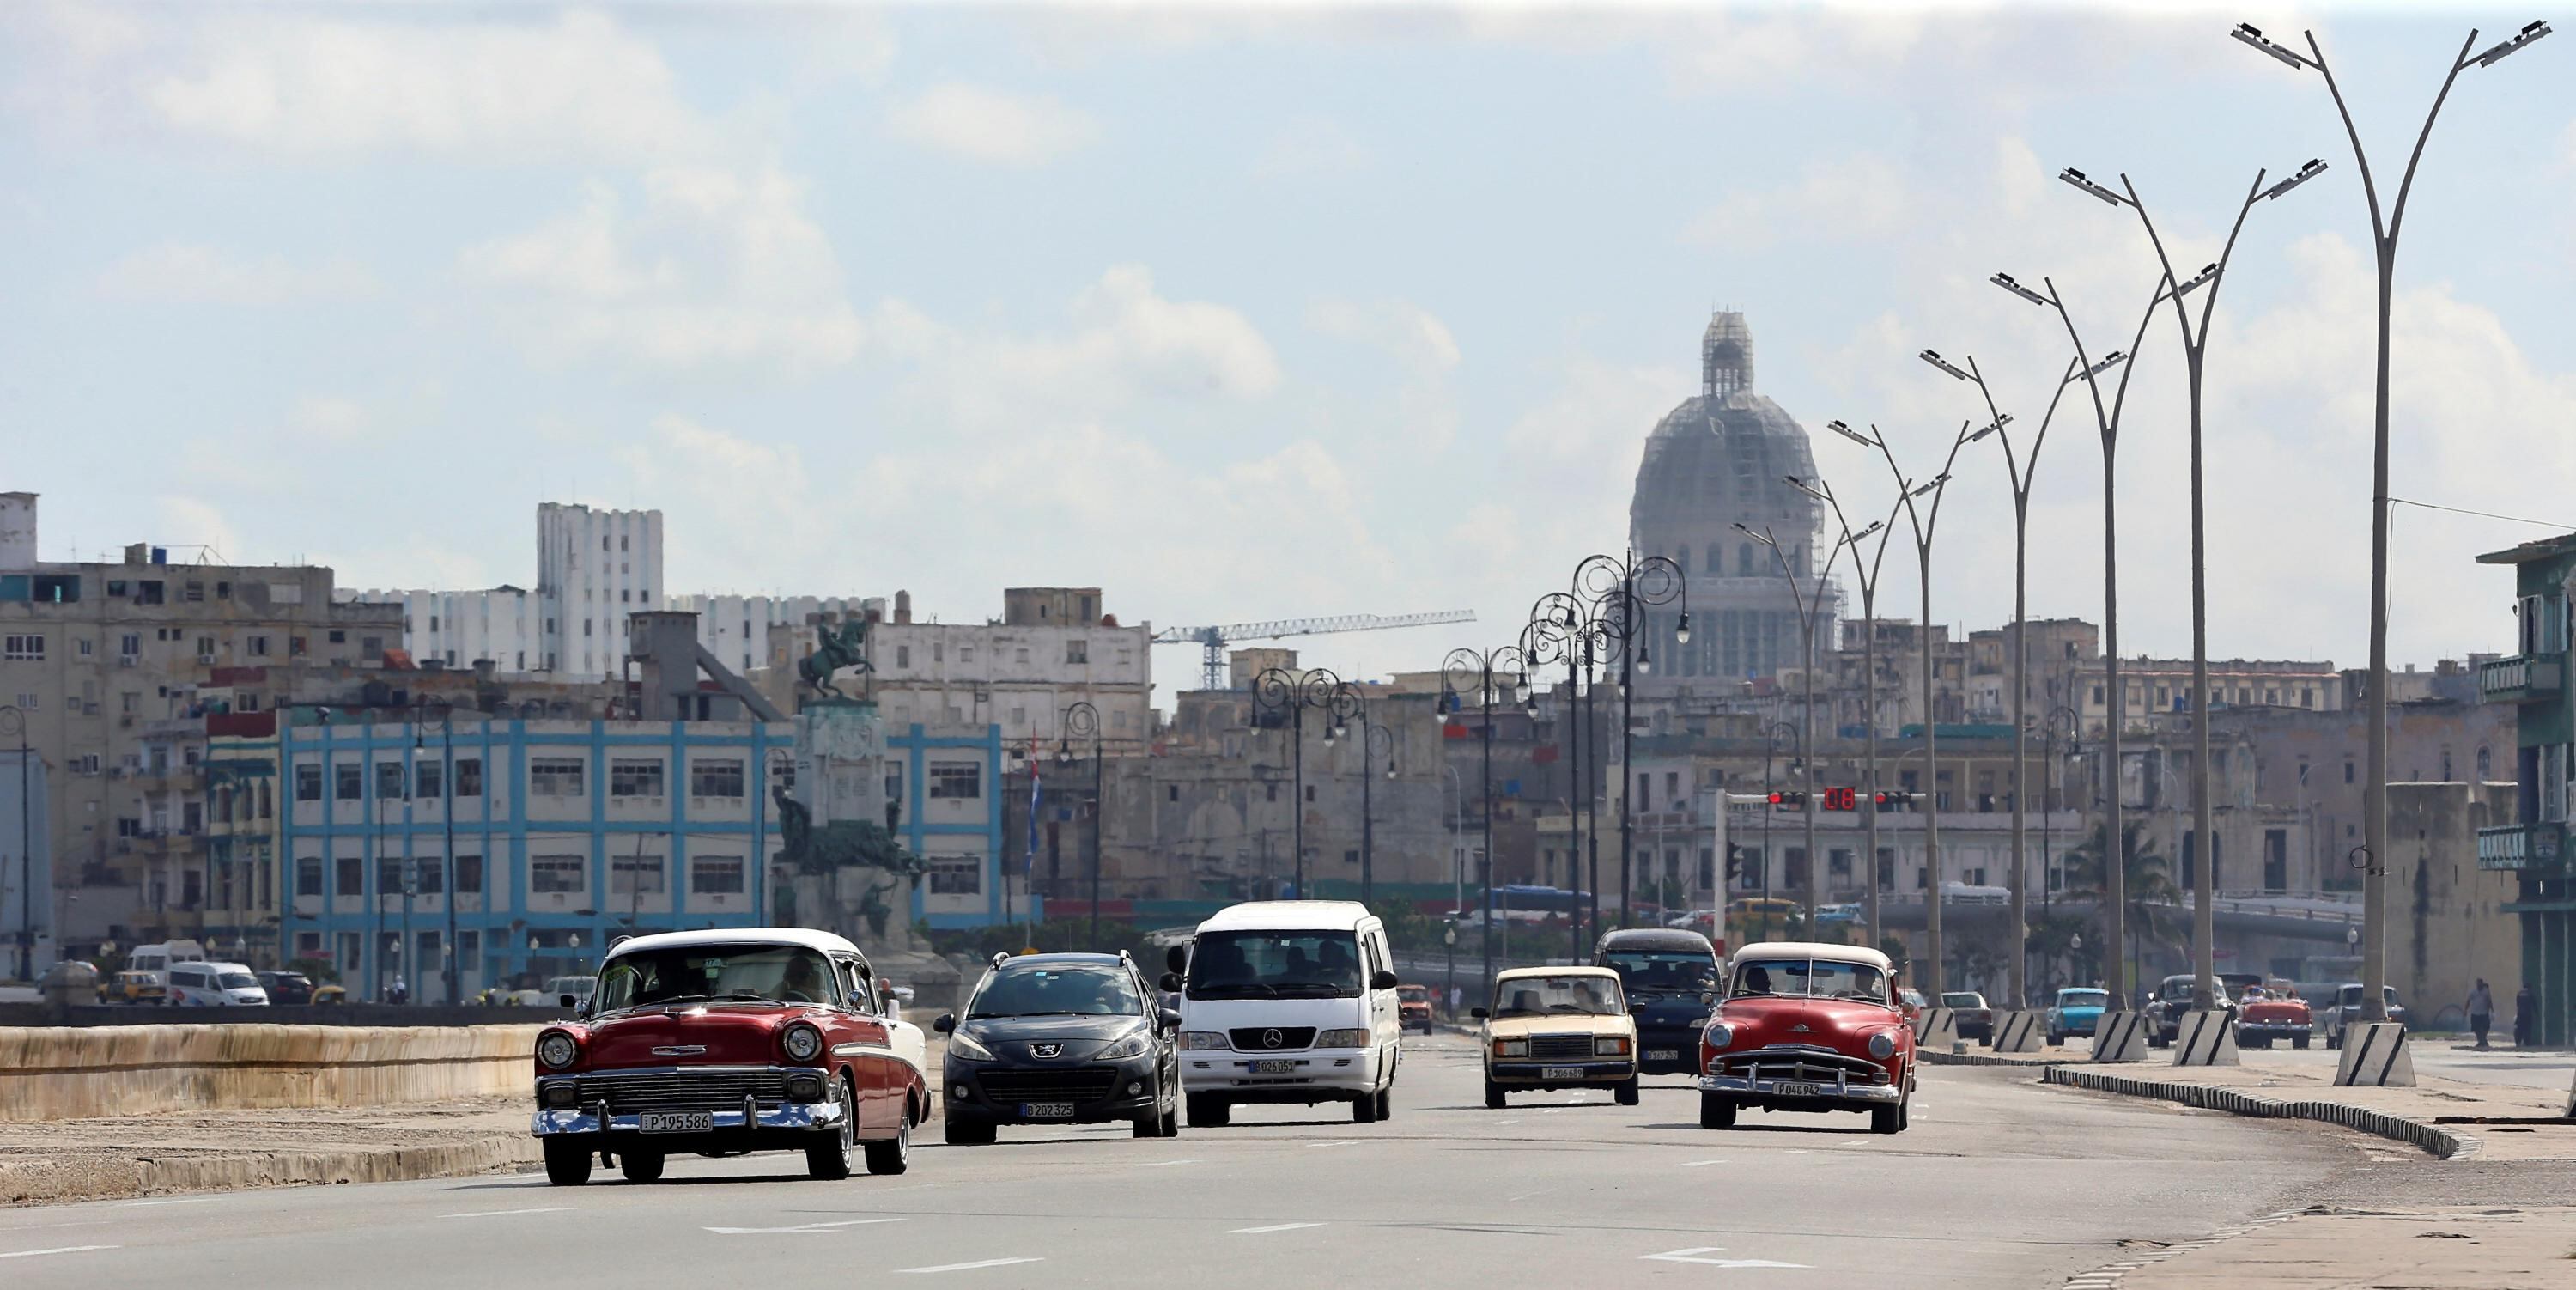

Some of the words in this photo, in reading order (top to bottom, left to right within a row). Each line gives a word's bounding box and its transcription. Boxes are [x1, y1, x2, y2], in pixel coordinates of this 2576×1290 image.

[1825, 787, 1856, 811] 08
[1035, 1104, 1053, 1116] 202
[651, 1116, 659, 1129] P
[660, 1116, 683, 1129] 195
[686, 1115, 709, 1129] 586
